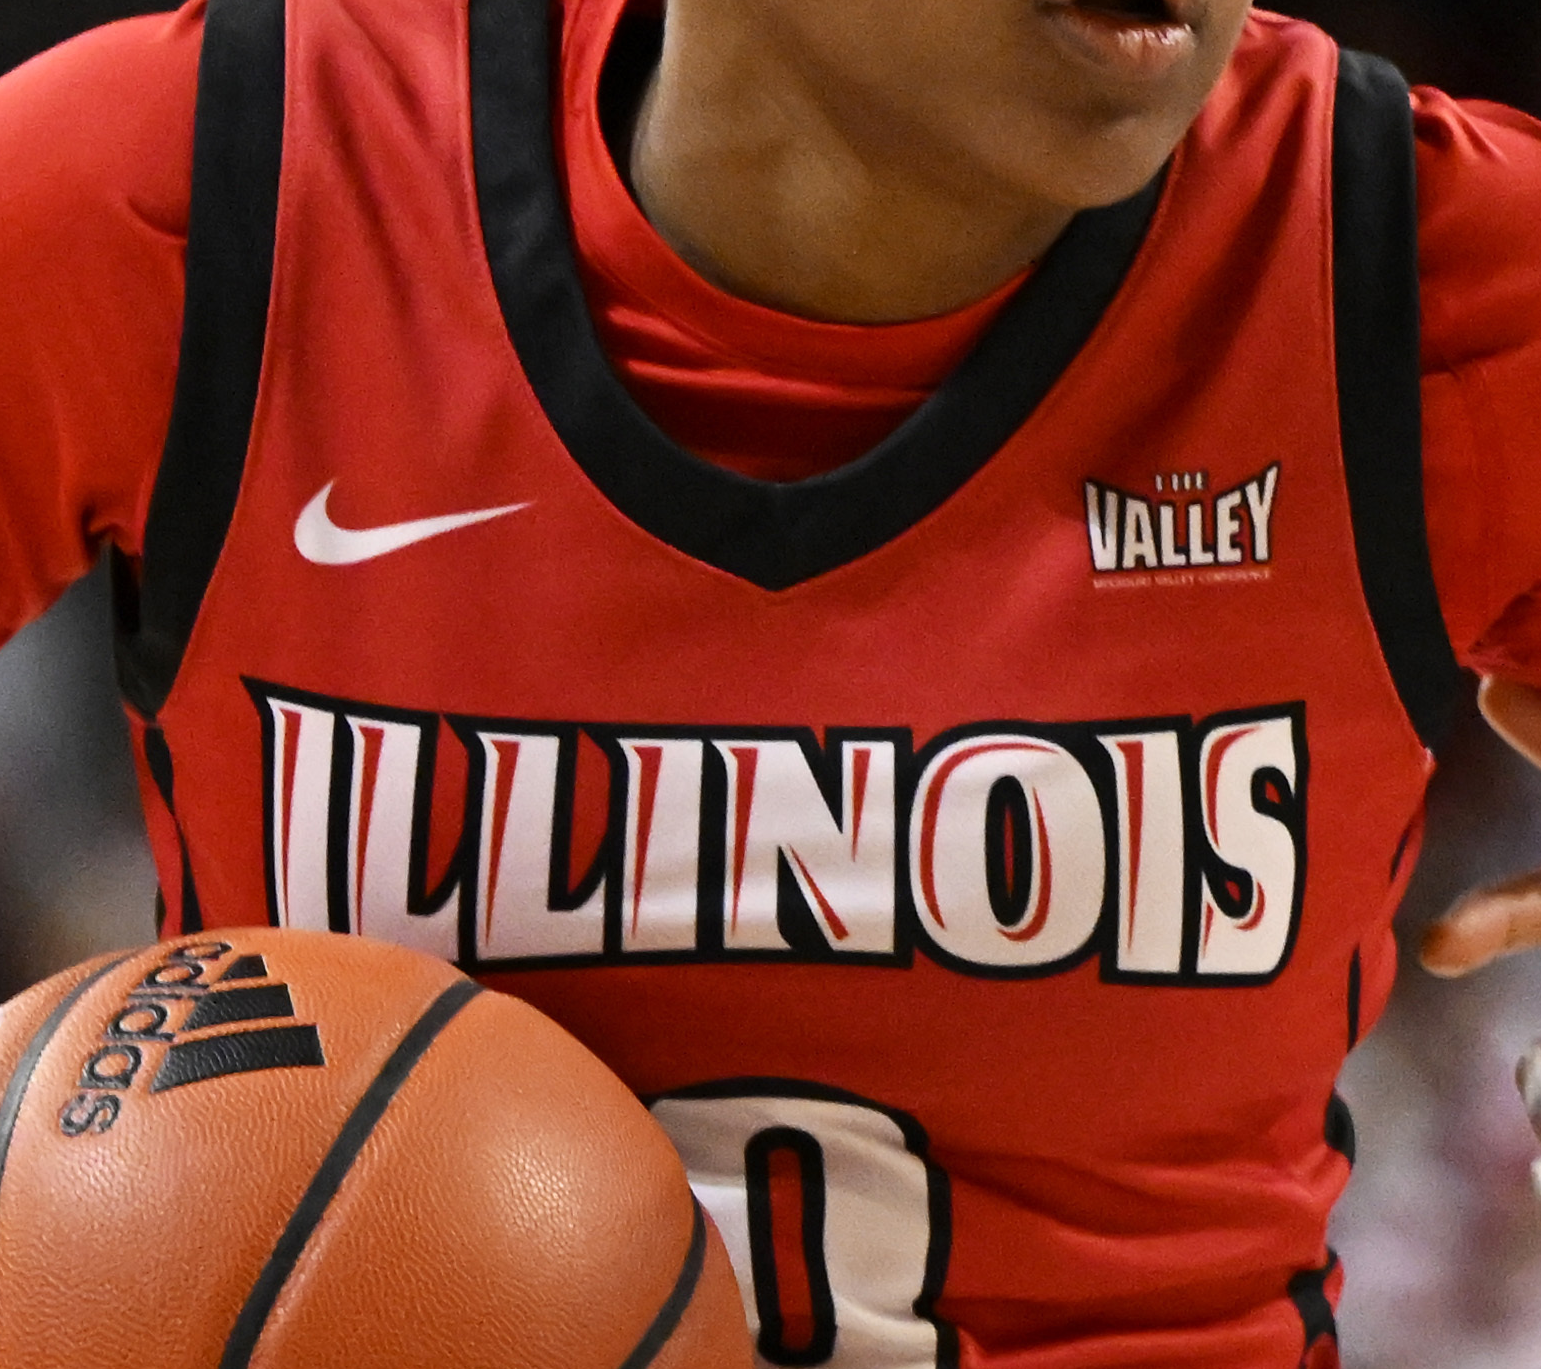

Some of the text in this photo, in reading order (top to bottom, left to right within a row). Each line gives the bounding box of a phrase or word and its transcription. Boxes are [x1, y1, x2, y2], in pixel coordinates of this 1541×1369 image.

[1084, 465, 1279, 571] VALLEY
[247, 680, 1305, 986] ILLINOIS
[59, 941, 233, 1138] adidas
